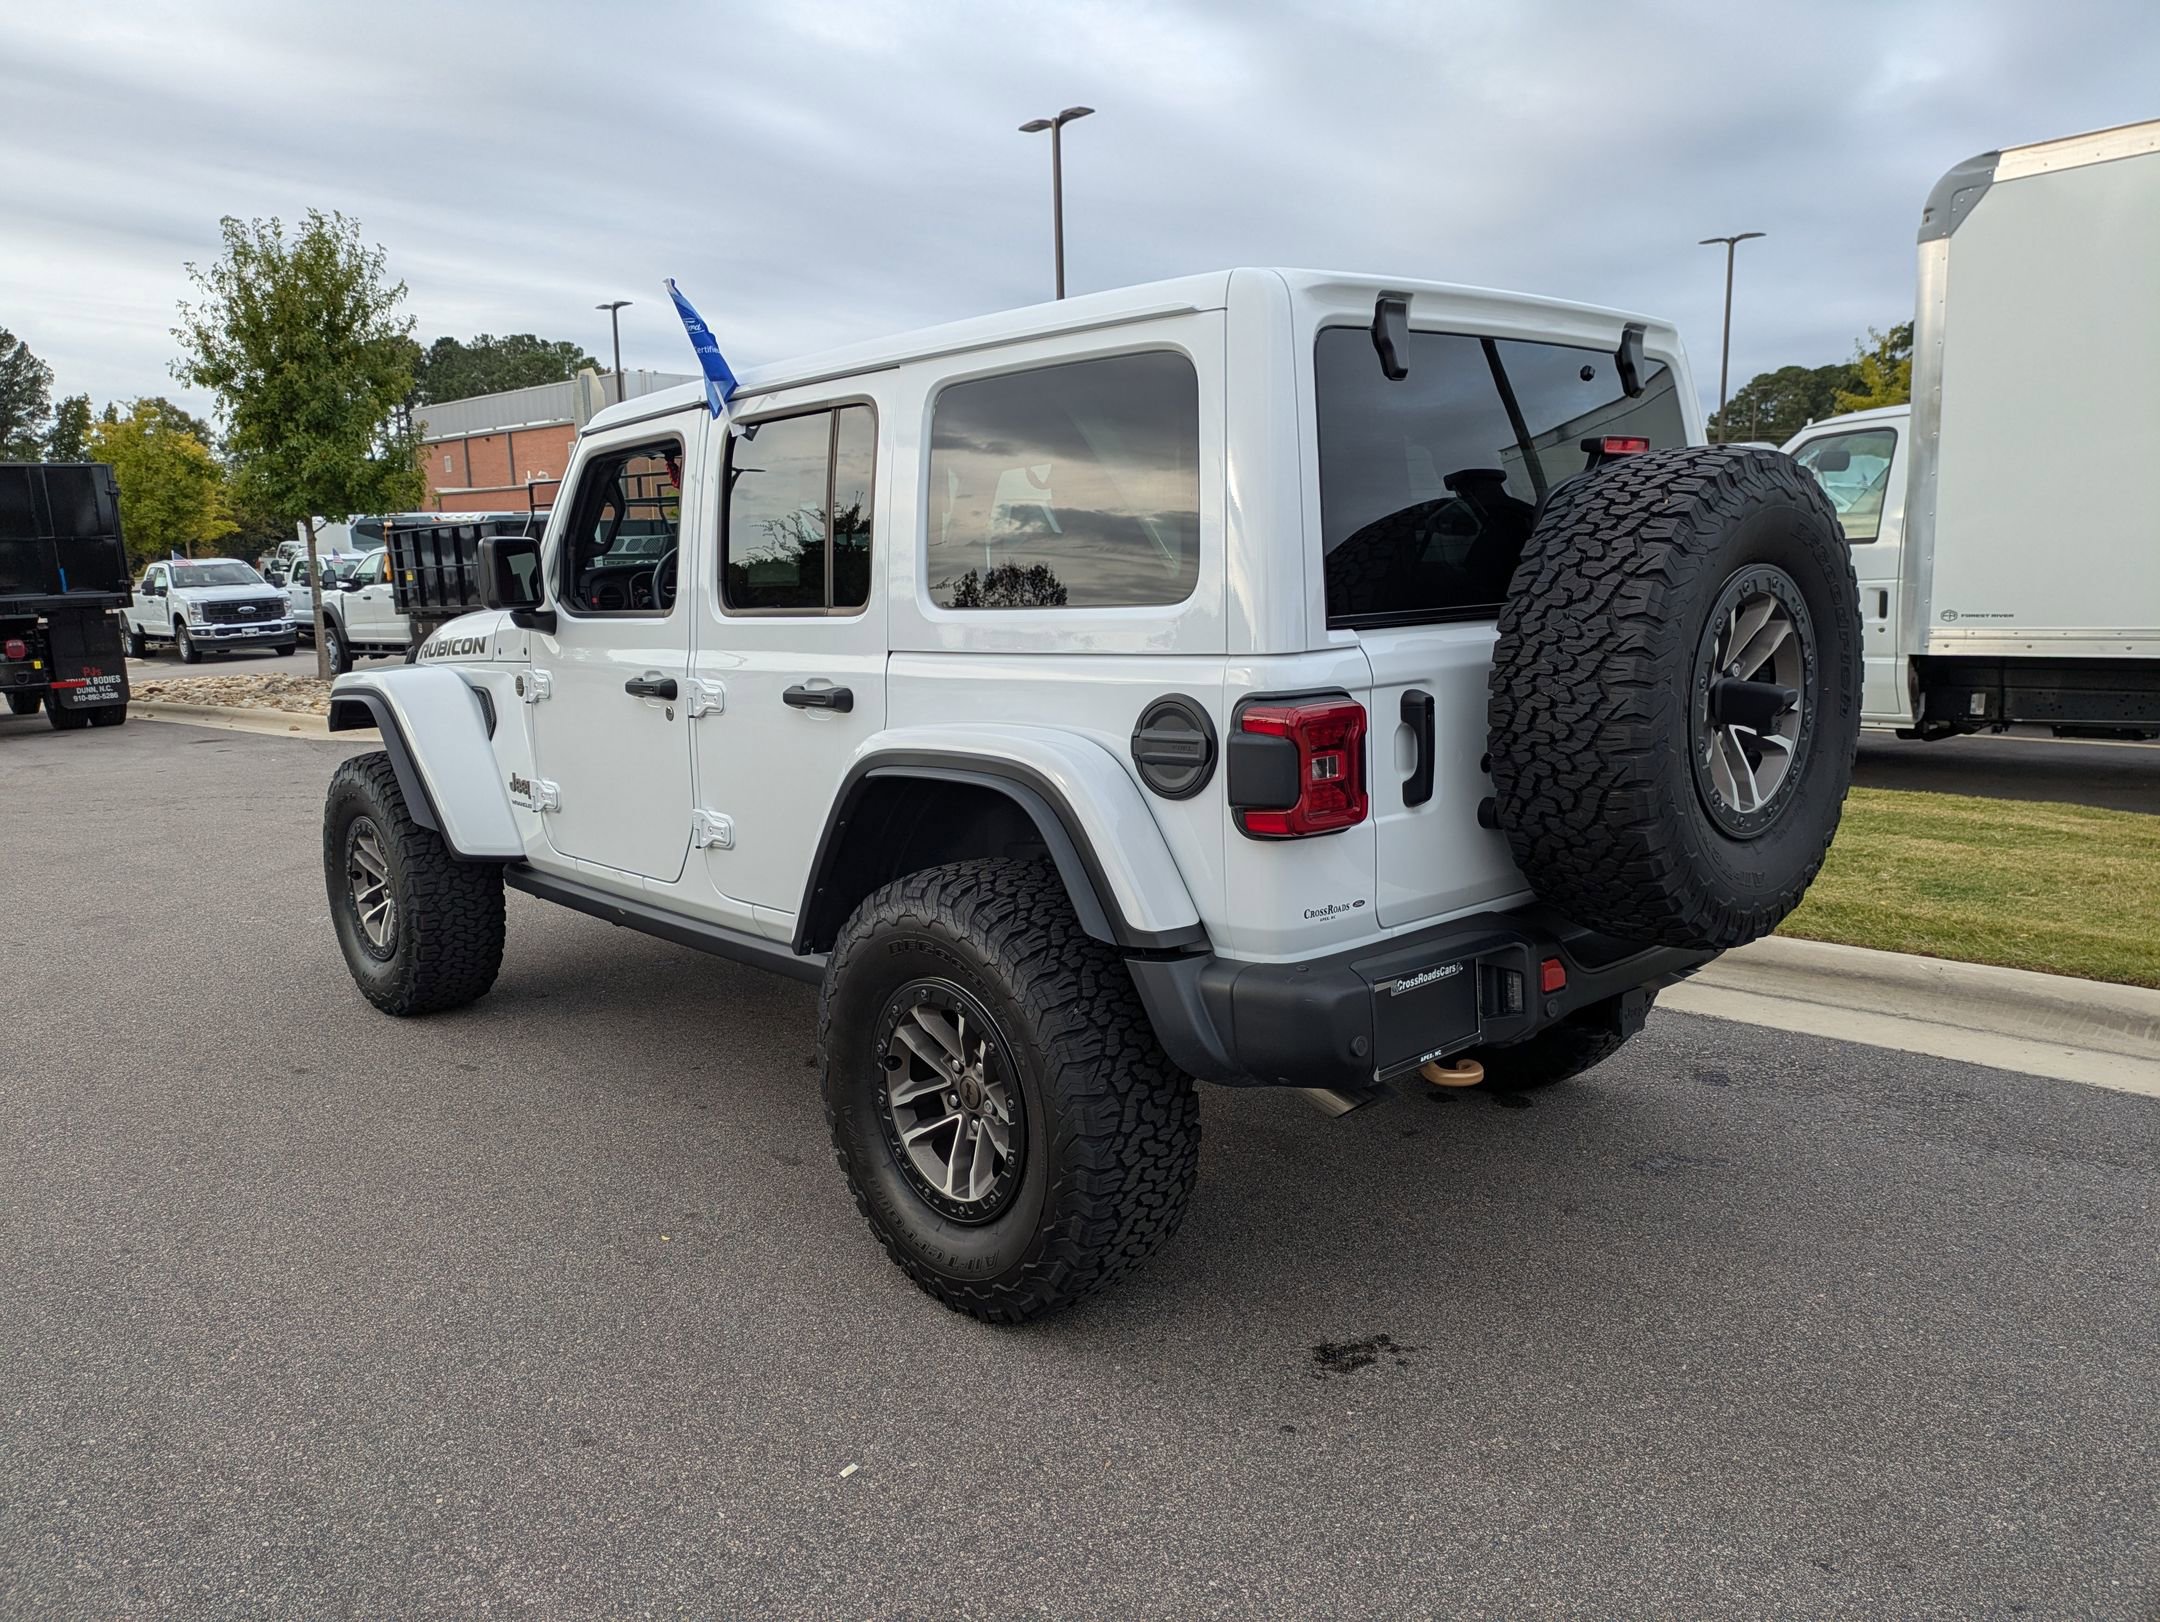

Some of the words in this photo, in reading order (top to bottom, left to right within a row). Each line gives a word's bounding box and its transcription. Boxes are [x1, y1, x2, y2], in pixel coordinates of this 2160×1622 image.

[695, 345, 720, 354] ertifie
[419, 636, 486, 659] RUBICON
[93, 675, 121, 685] BODIES
[99, 685, 114, 693] N.C.
[1397, 964, 1456, 992] CrossRoadsCars
